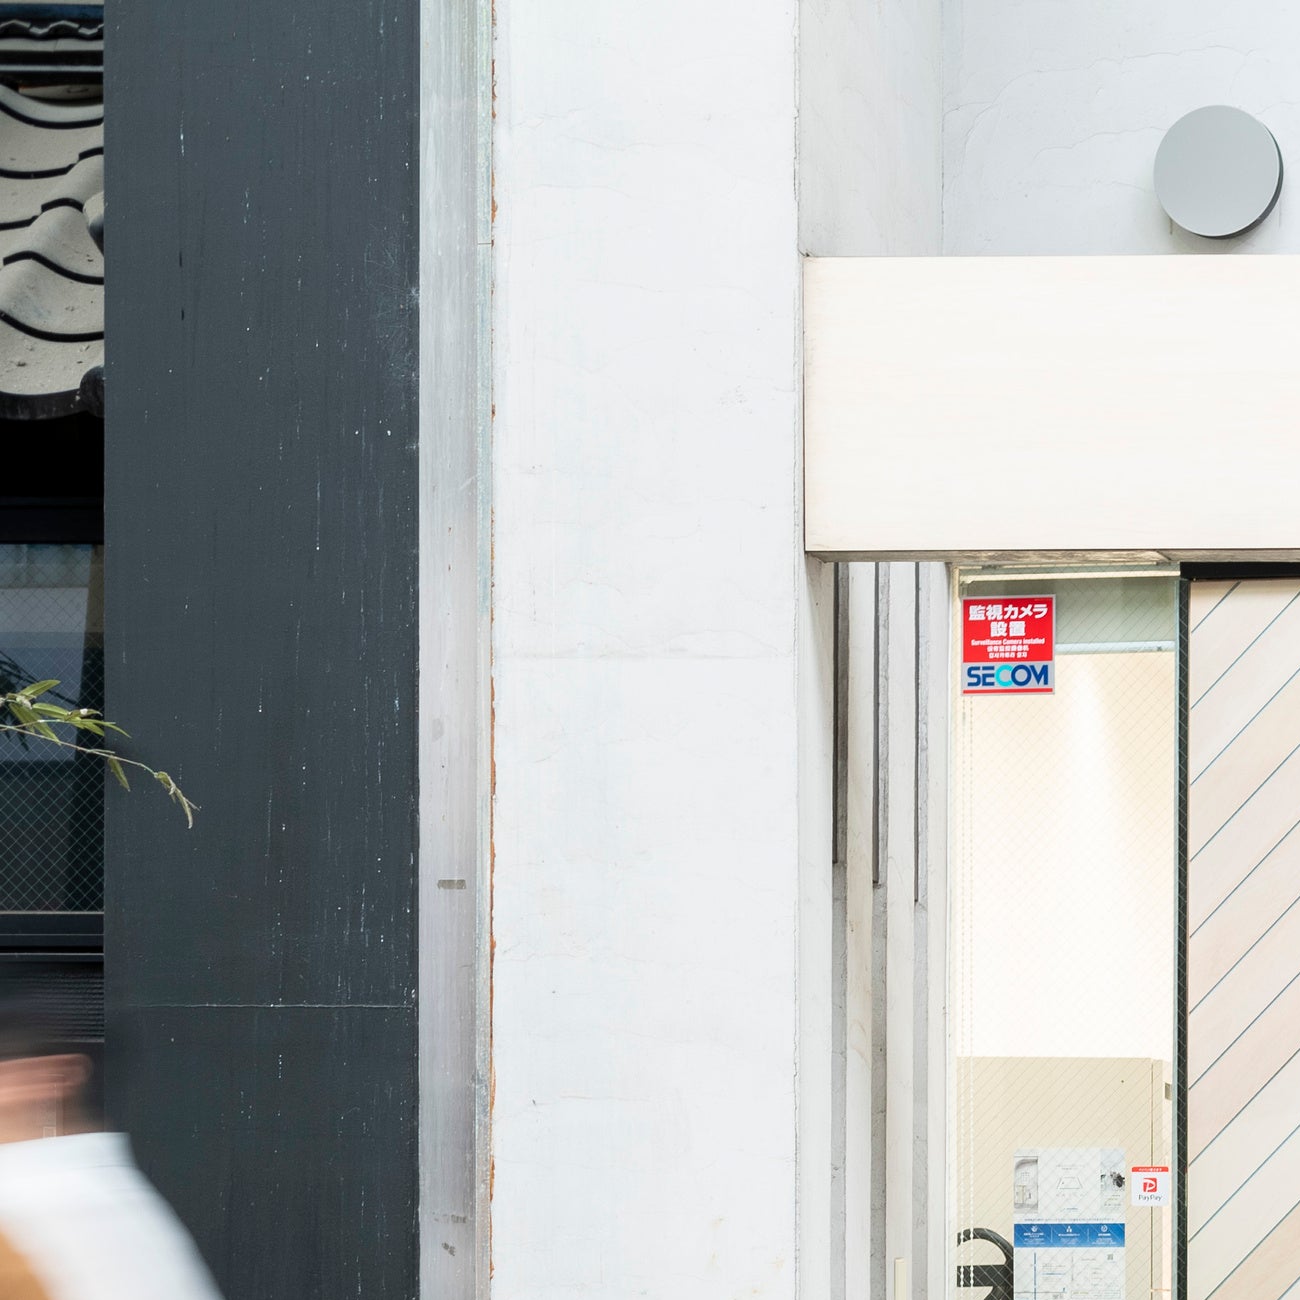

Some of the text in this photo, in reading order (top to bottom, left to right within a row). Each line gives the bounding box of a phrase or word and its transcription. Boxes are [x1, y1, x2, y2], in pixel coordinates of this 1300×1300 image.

[969, 604, 1048, 621] 監視カメラ
[990, 620, 1026, 637] 設置
[966, 664, 1049, 687] SECOM
[1138, 1194, 1162, 1202] PayPay
